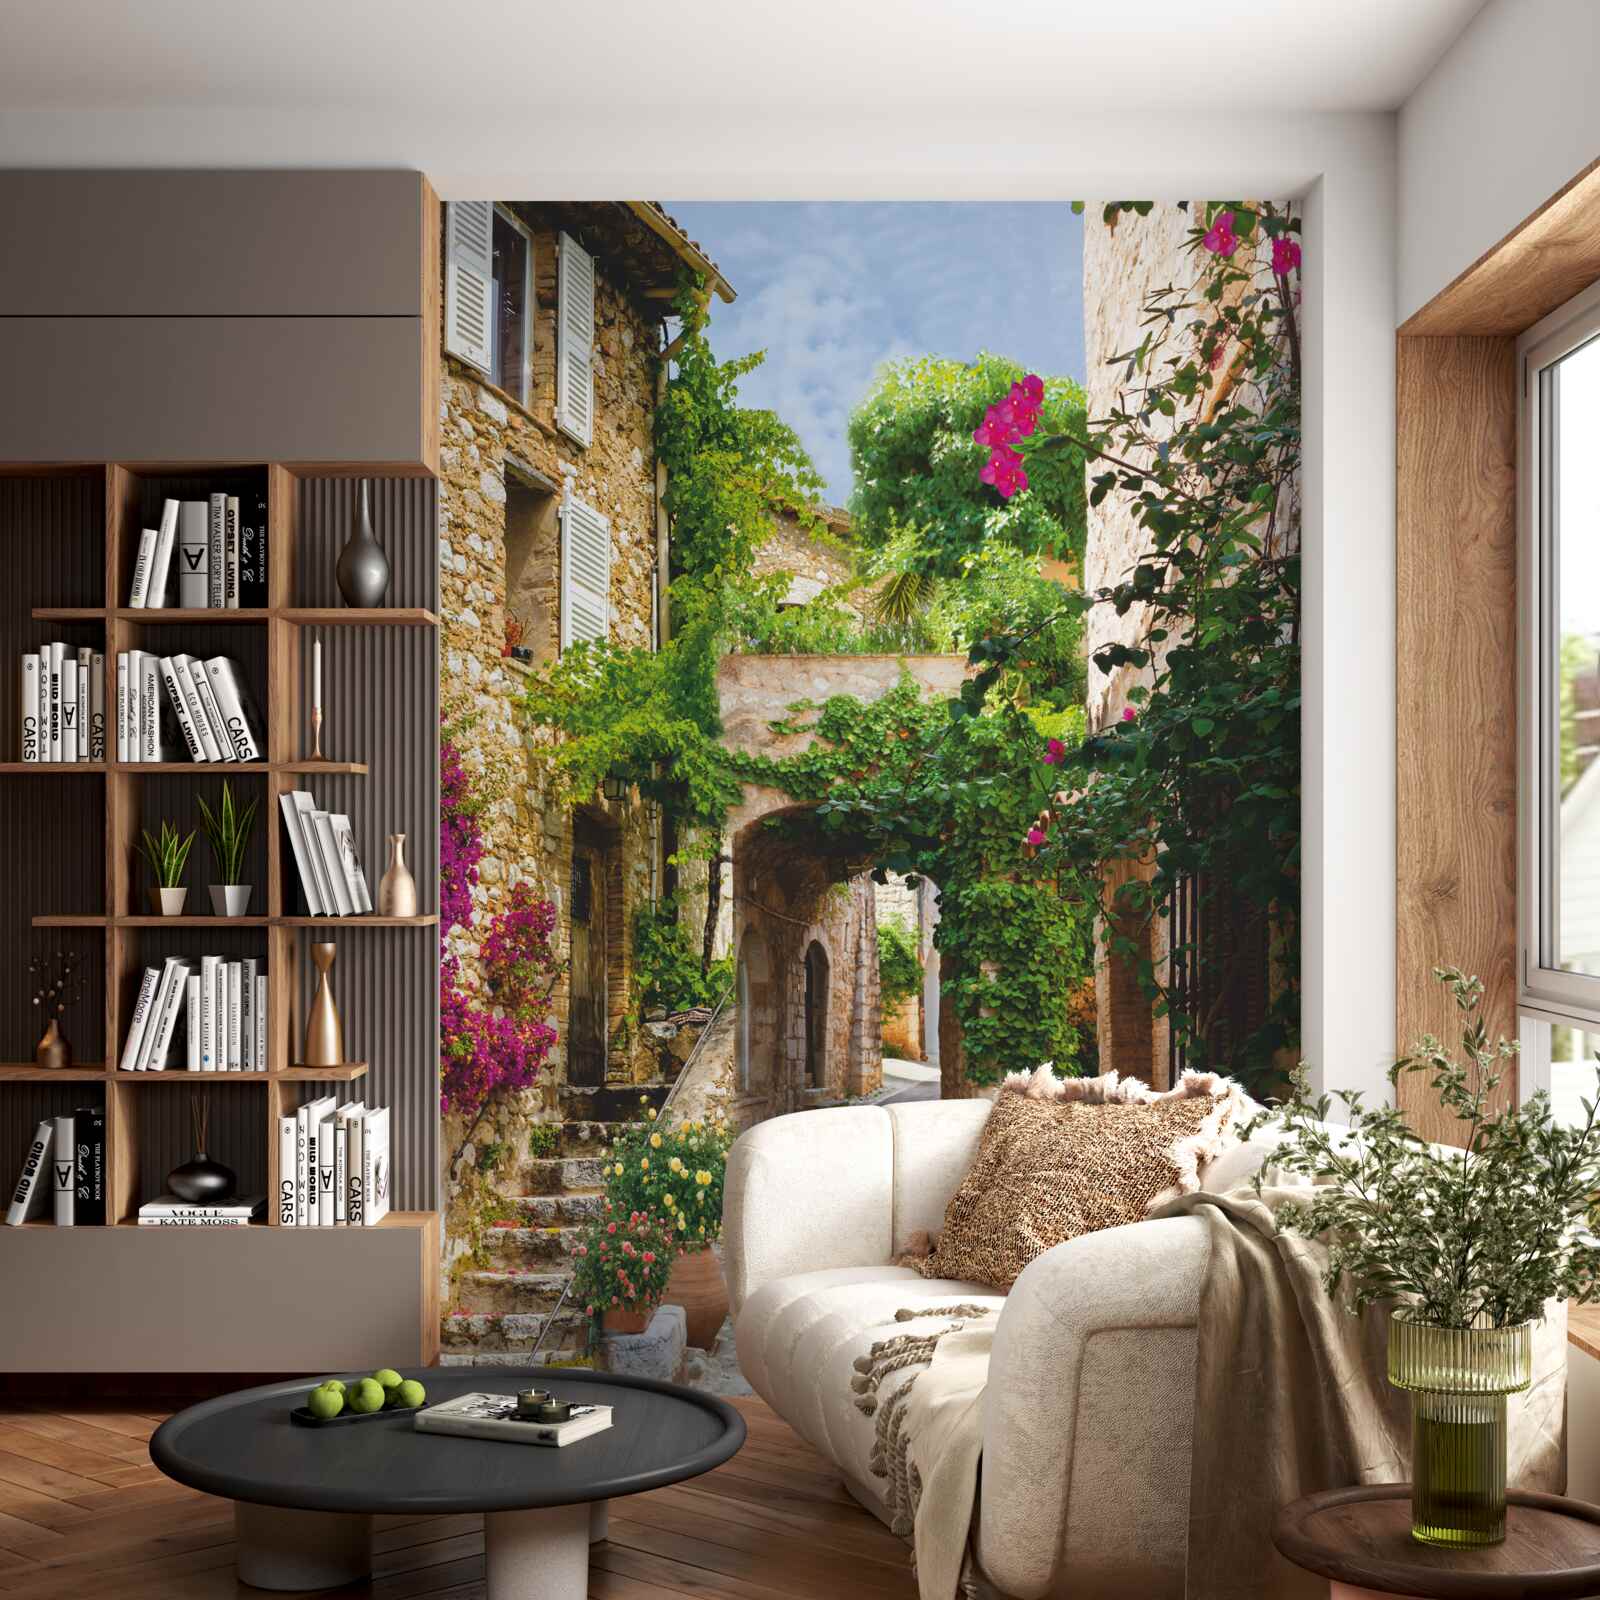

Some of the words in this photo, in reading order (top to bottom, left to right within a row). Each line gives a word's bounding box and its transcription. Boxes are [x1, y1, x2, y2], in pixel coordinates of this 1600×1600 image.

[213, 506, 221, 519] TIM
[213, 522, 221, 553] WALKER
[183, 548, 205, 570] A
[227, 562, 235, 599] LIVING
[63, 706, 75, 726] A
[165, 675, 185, 714] GYPSET
[182, 720, 199, 755] LIVING
[24, 716, 36, 760] CARS
[92, 713, 104, 758] CARS
[227, 716, 252, 760] CARS
[14, 1179, 31, 1204] WILD
[24, 1141, 44, 1177] WORLD
[56, 1165, 71, 1187] A
[321, 1170, 332, 1189] A
[171, 1209, 224, 1217] VOGUE
[281, 1180, 294, 1223] CARS
[350, 1177, 362, 1222] CARS
